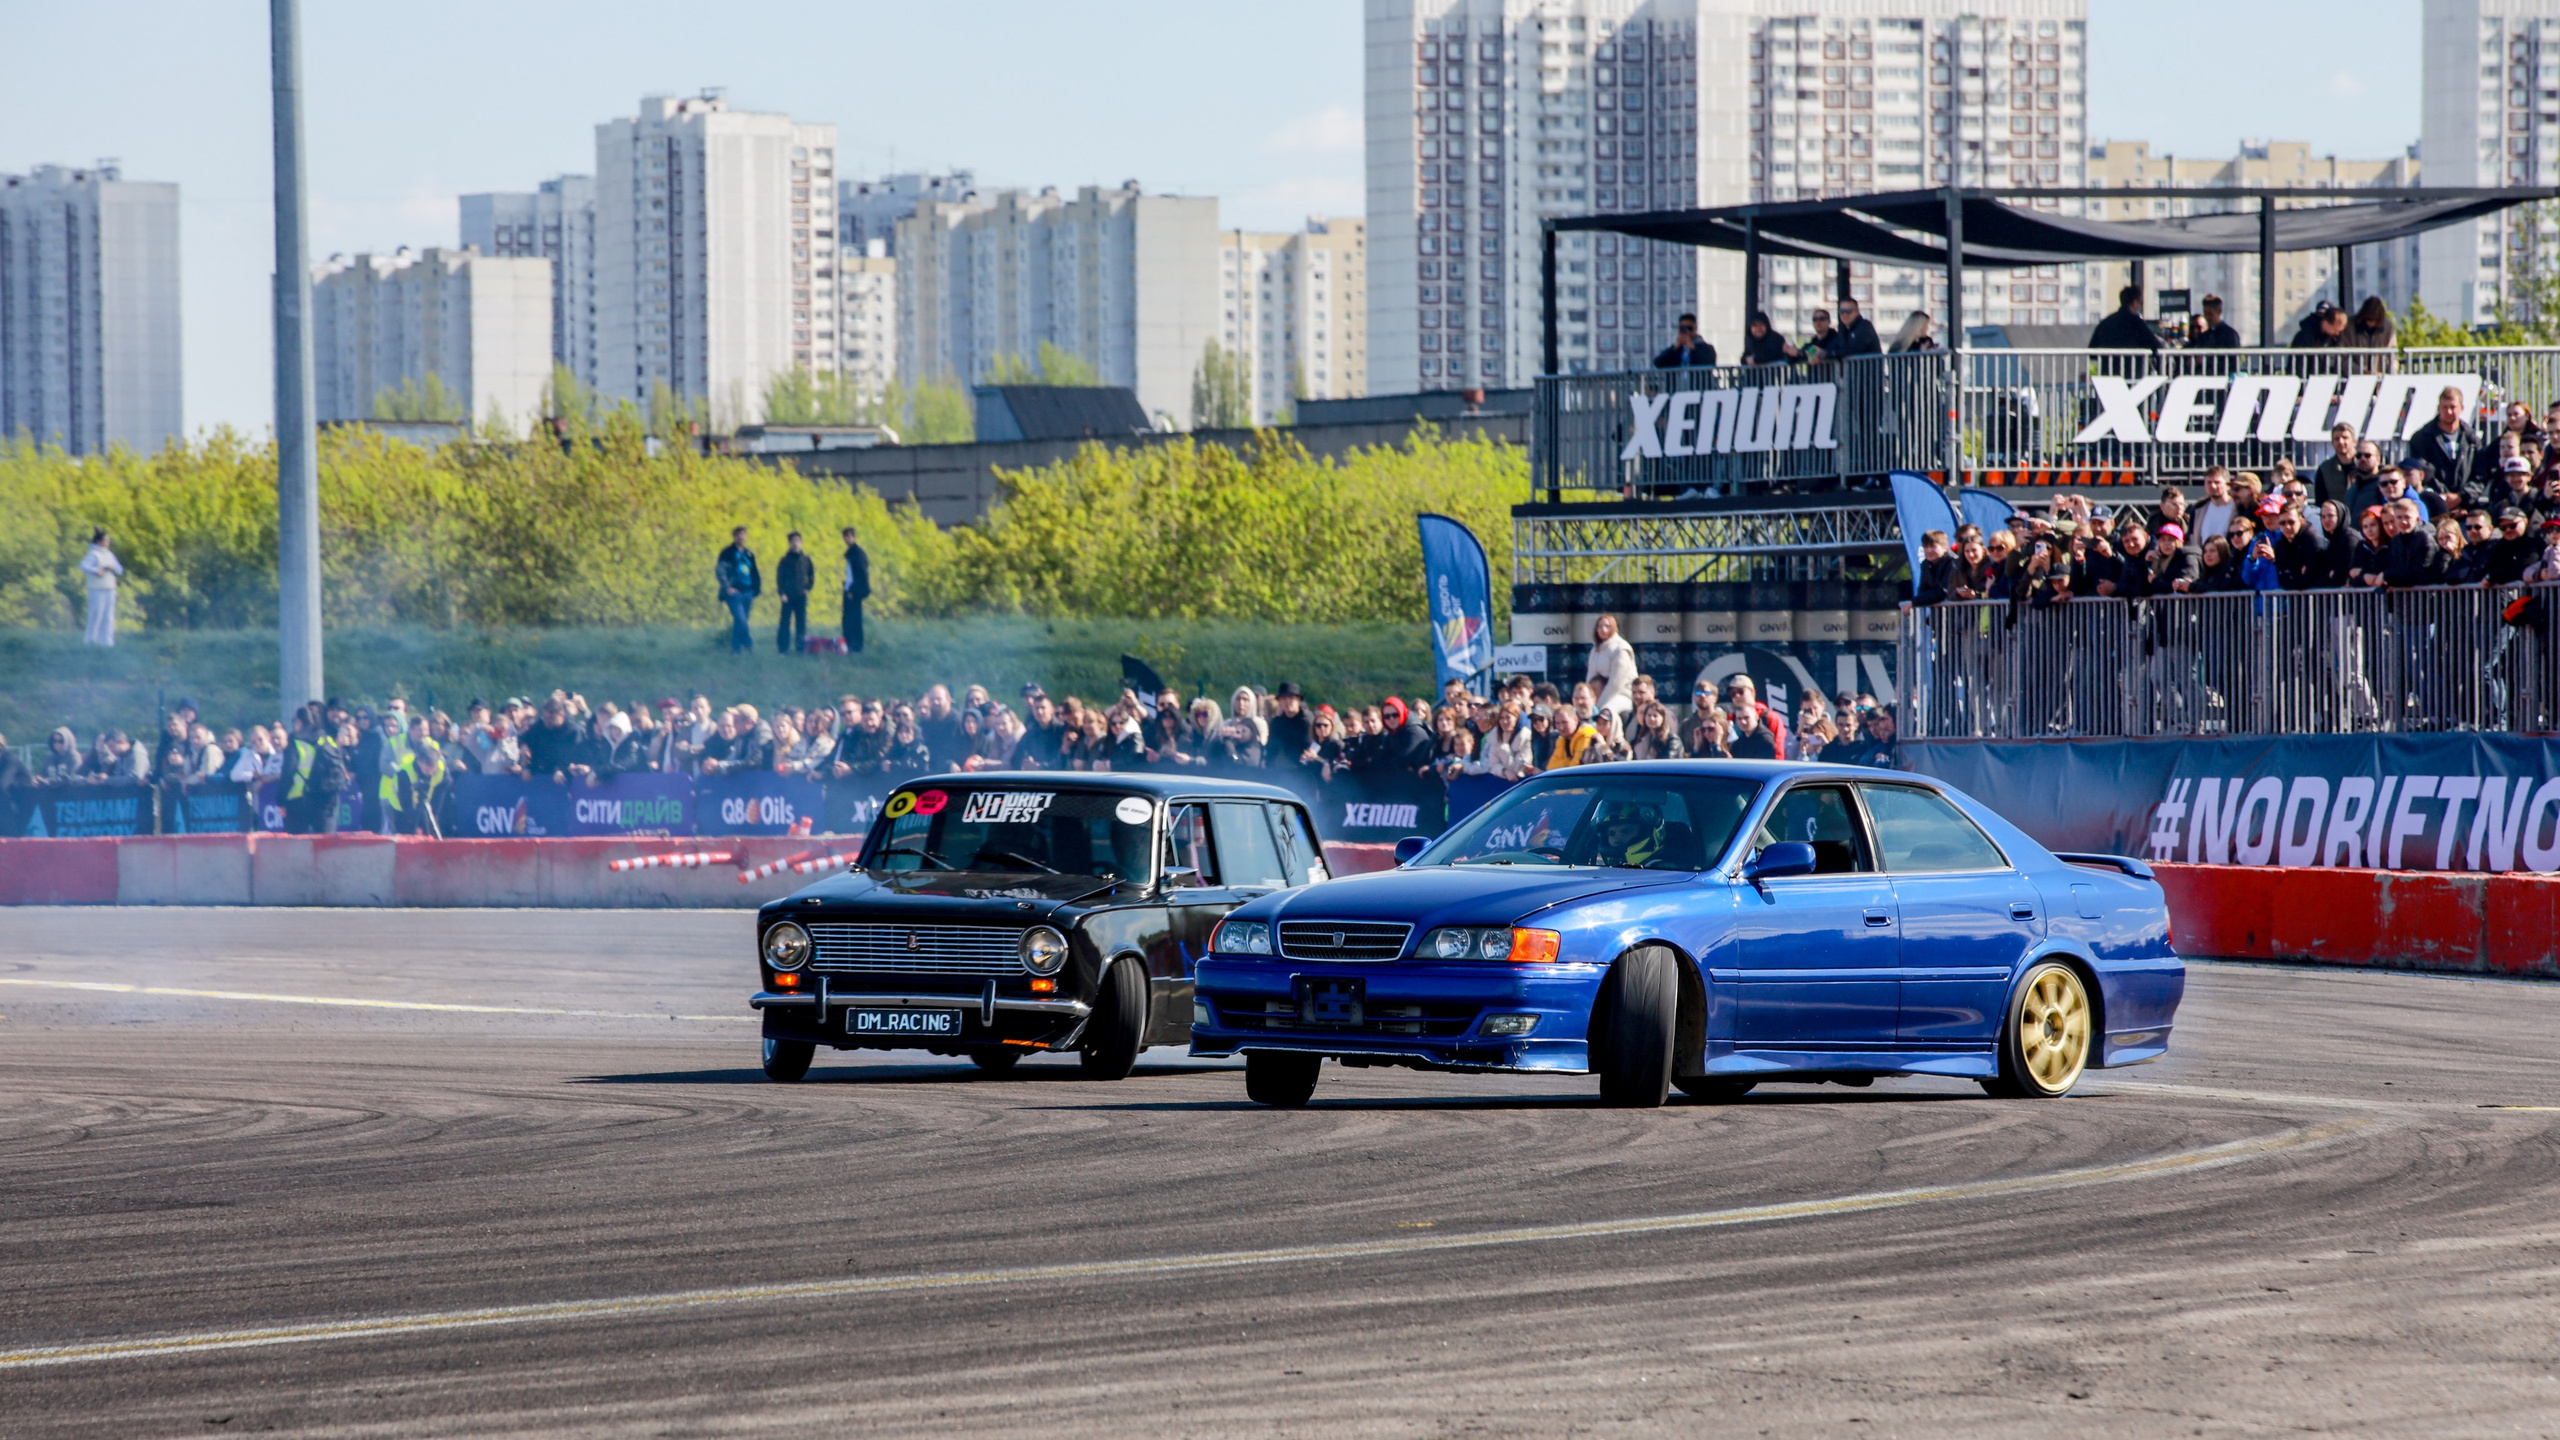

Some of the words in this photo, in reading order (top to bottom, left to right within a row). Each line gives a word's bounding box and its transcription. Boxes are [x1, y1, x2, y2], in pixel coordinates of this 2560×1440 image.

[1620, 382, 1838, 460] XENUM
[2072, 374, 2483, 443] XENUM
[1497, 656, 1520, 667] GNV
[55, 798, 138, 823] TSUNAMI
[722, 798, 745, 825] Q8
[760, 796, 795, 825] Oils
[1005, 792, 1056, 808] DRIFT
[476, 805, 515, 834] GNV
[1005, 807, 1044, 823] FEST
[1342, 802, 1418, 828] XENUM
[858, 1013, 951, 1031] DM_RACING
